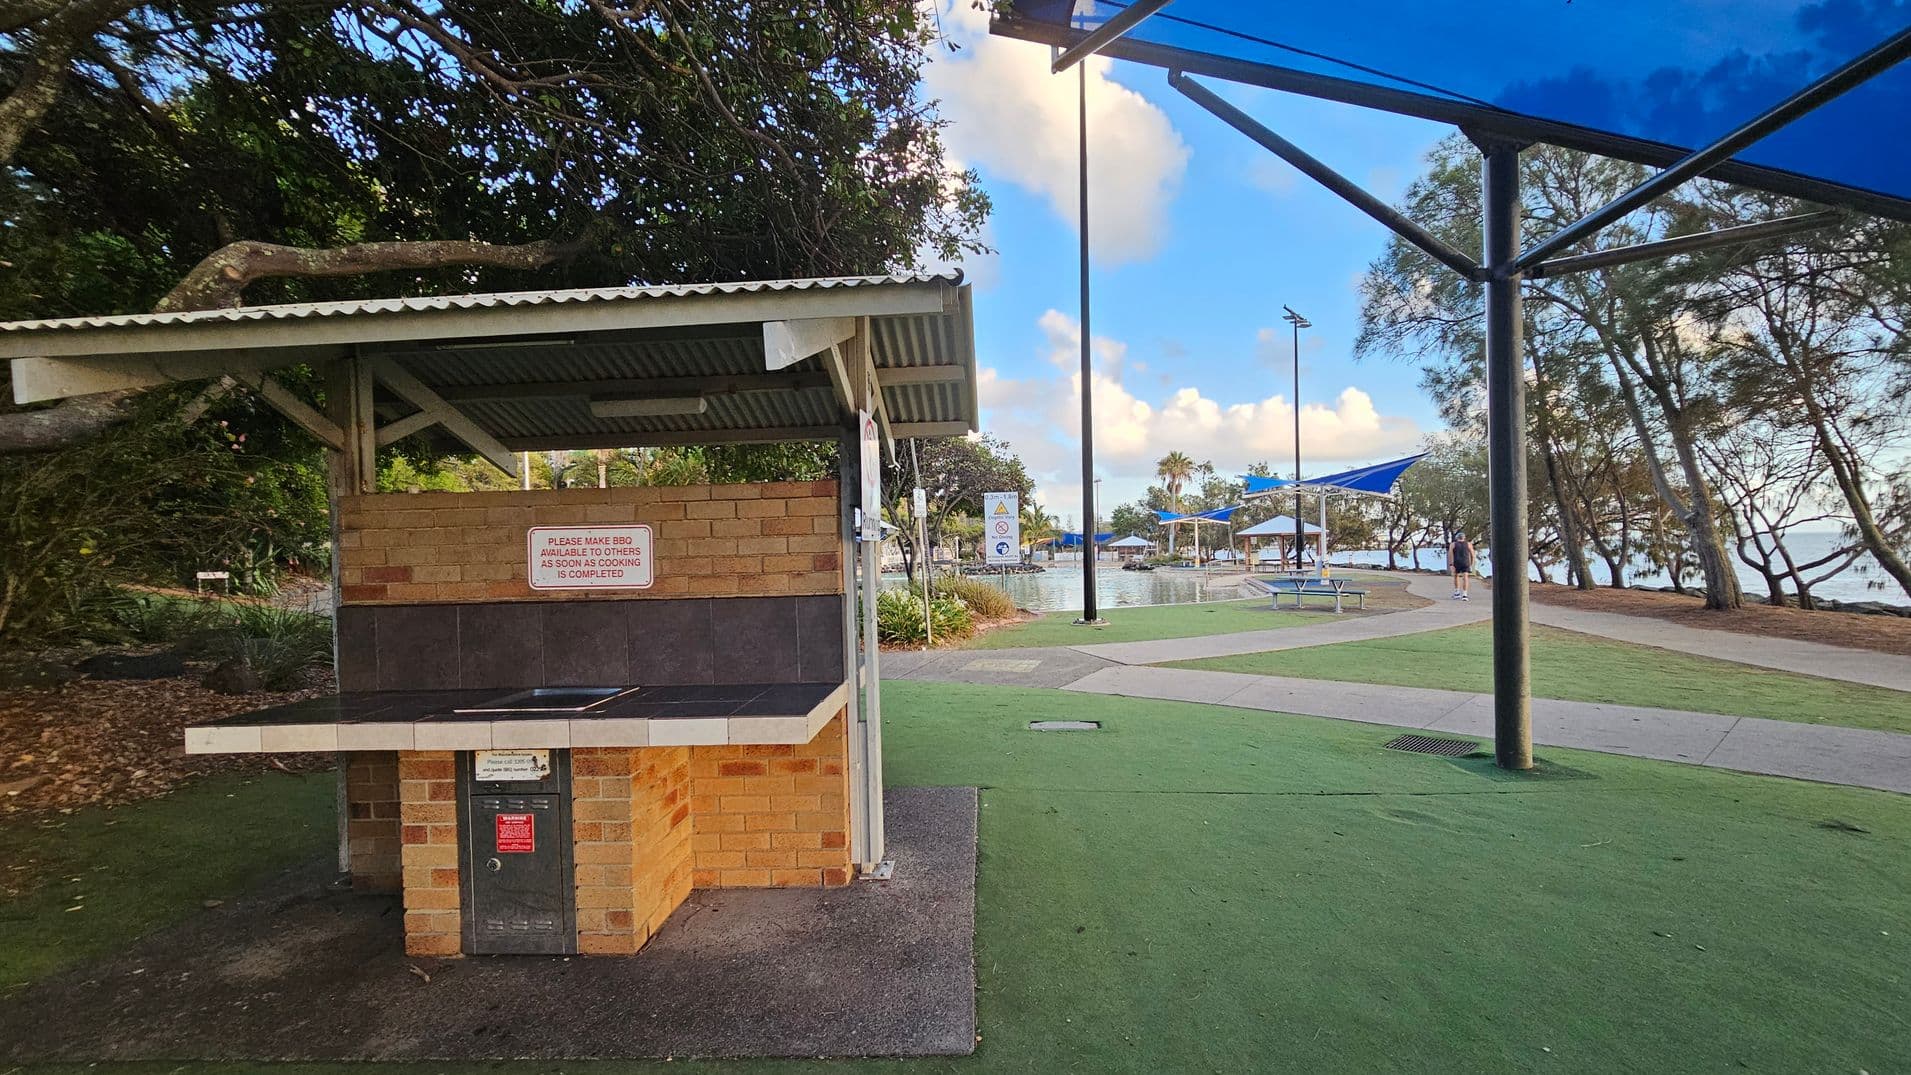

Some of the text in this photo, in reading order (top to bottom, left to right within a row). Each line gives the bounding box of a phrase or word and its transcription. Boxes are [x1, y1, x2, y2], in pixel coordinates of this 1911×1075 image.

[585, 537, 610, 545] MAKE
[613, 537, 633, 545] BBQ
[541, 547, 641, 557] AVAILABLE TO OTHERS
[541, 558, 641, 568] AS SOON AS COOKING
[558, 570, 624, 578] IS COMPLETED
